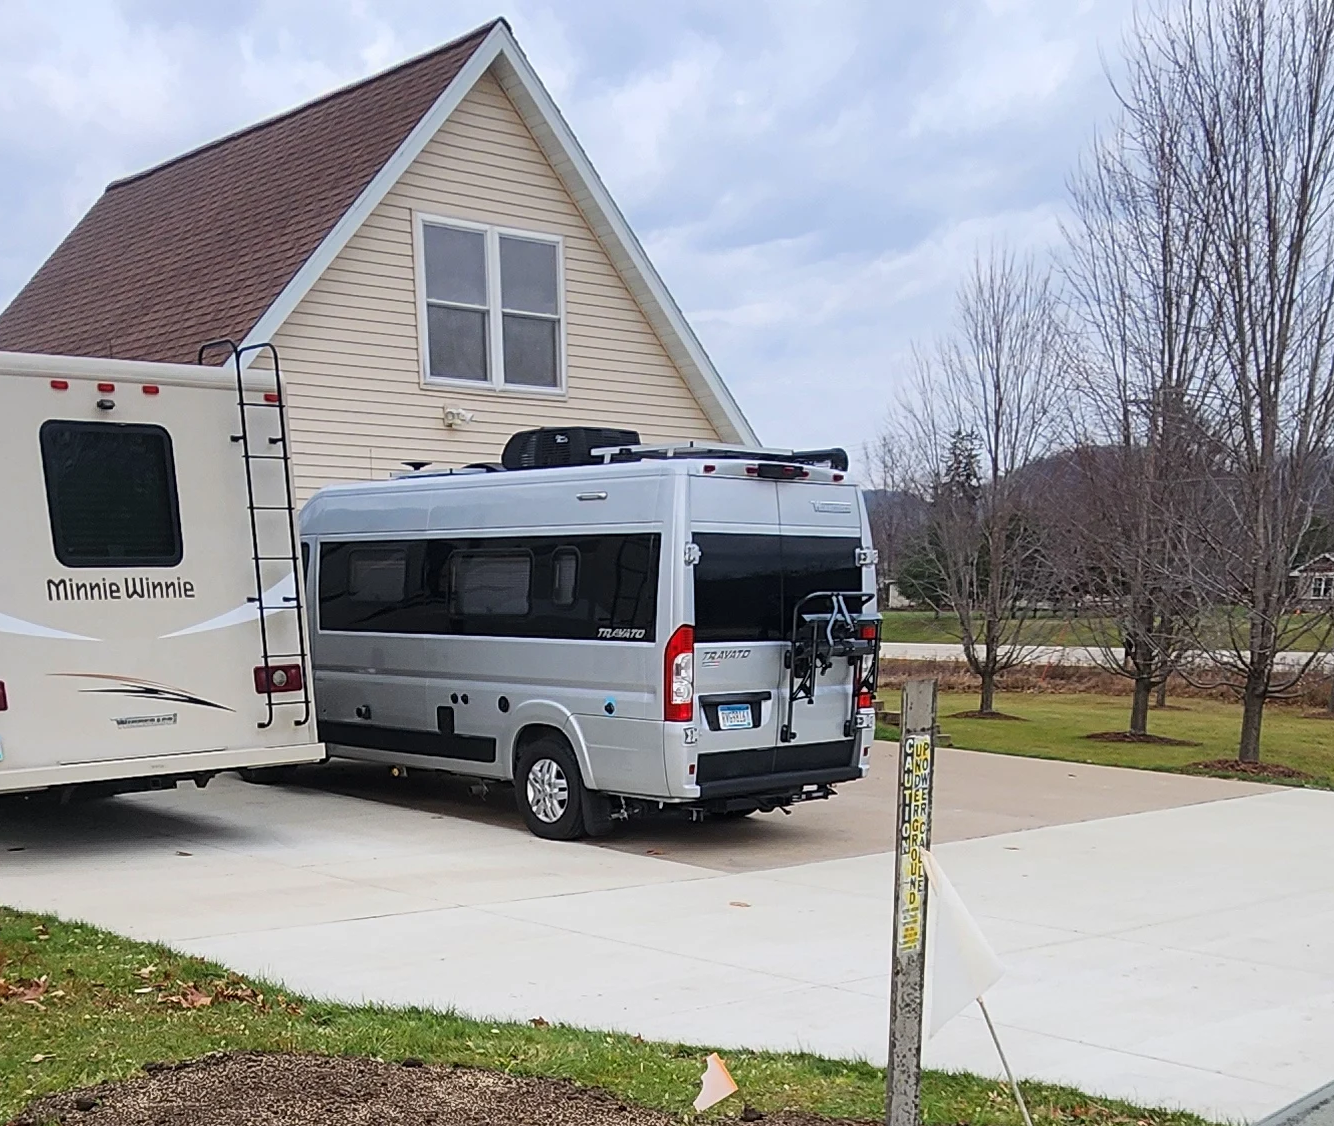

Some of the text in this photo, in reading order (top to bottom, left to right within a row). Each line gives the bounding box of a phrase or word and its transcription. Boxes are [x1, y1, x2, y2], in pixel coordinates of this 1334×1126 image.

[46, 576, 195, 601] Minnie Winnie
[597, 627, 646, 639] TRAVATO
[702, 649, 751, 661] TRAVATO
[901, 738, 914, 855] CAUTION
[920, 742, 930, 817] POWER
[909, 743, 922, 905] UNDERGROUND
